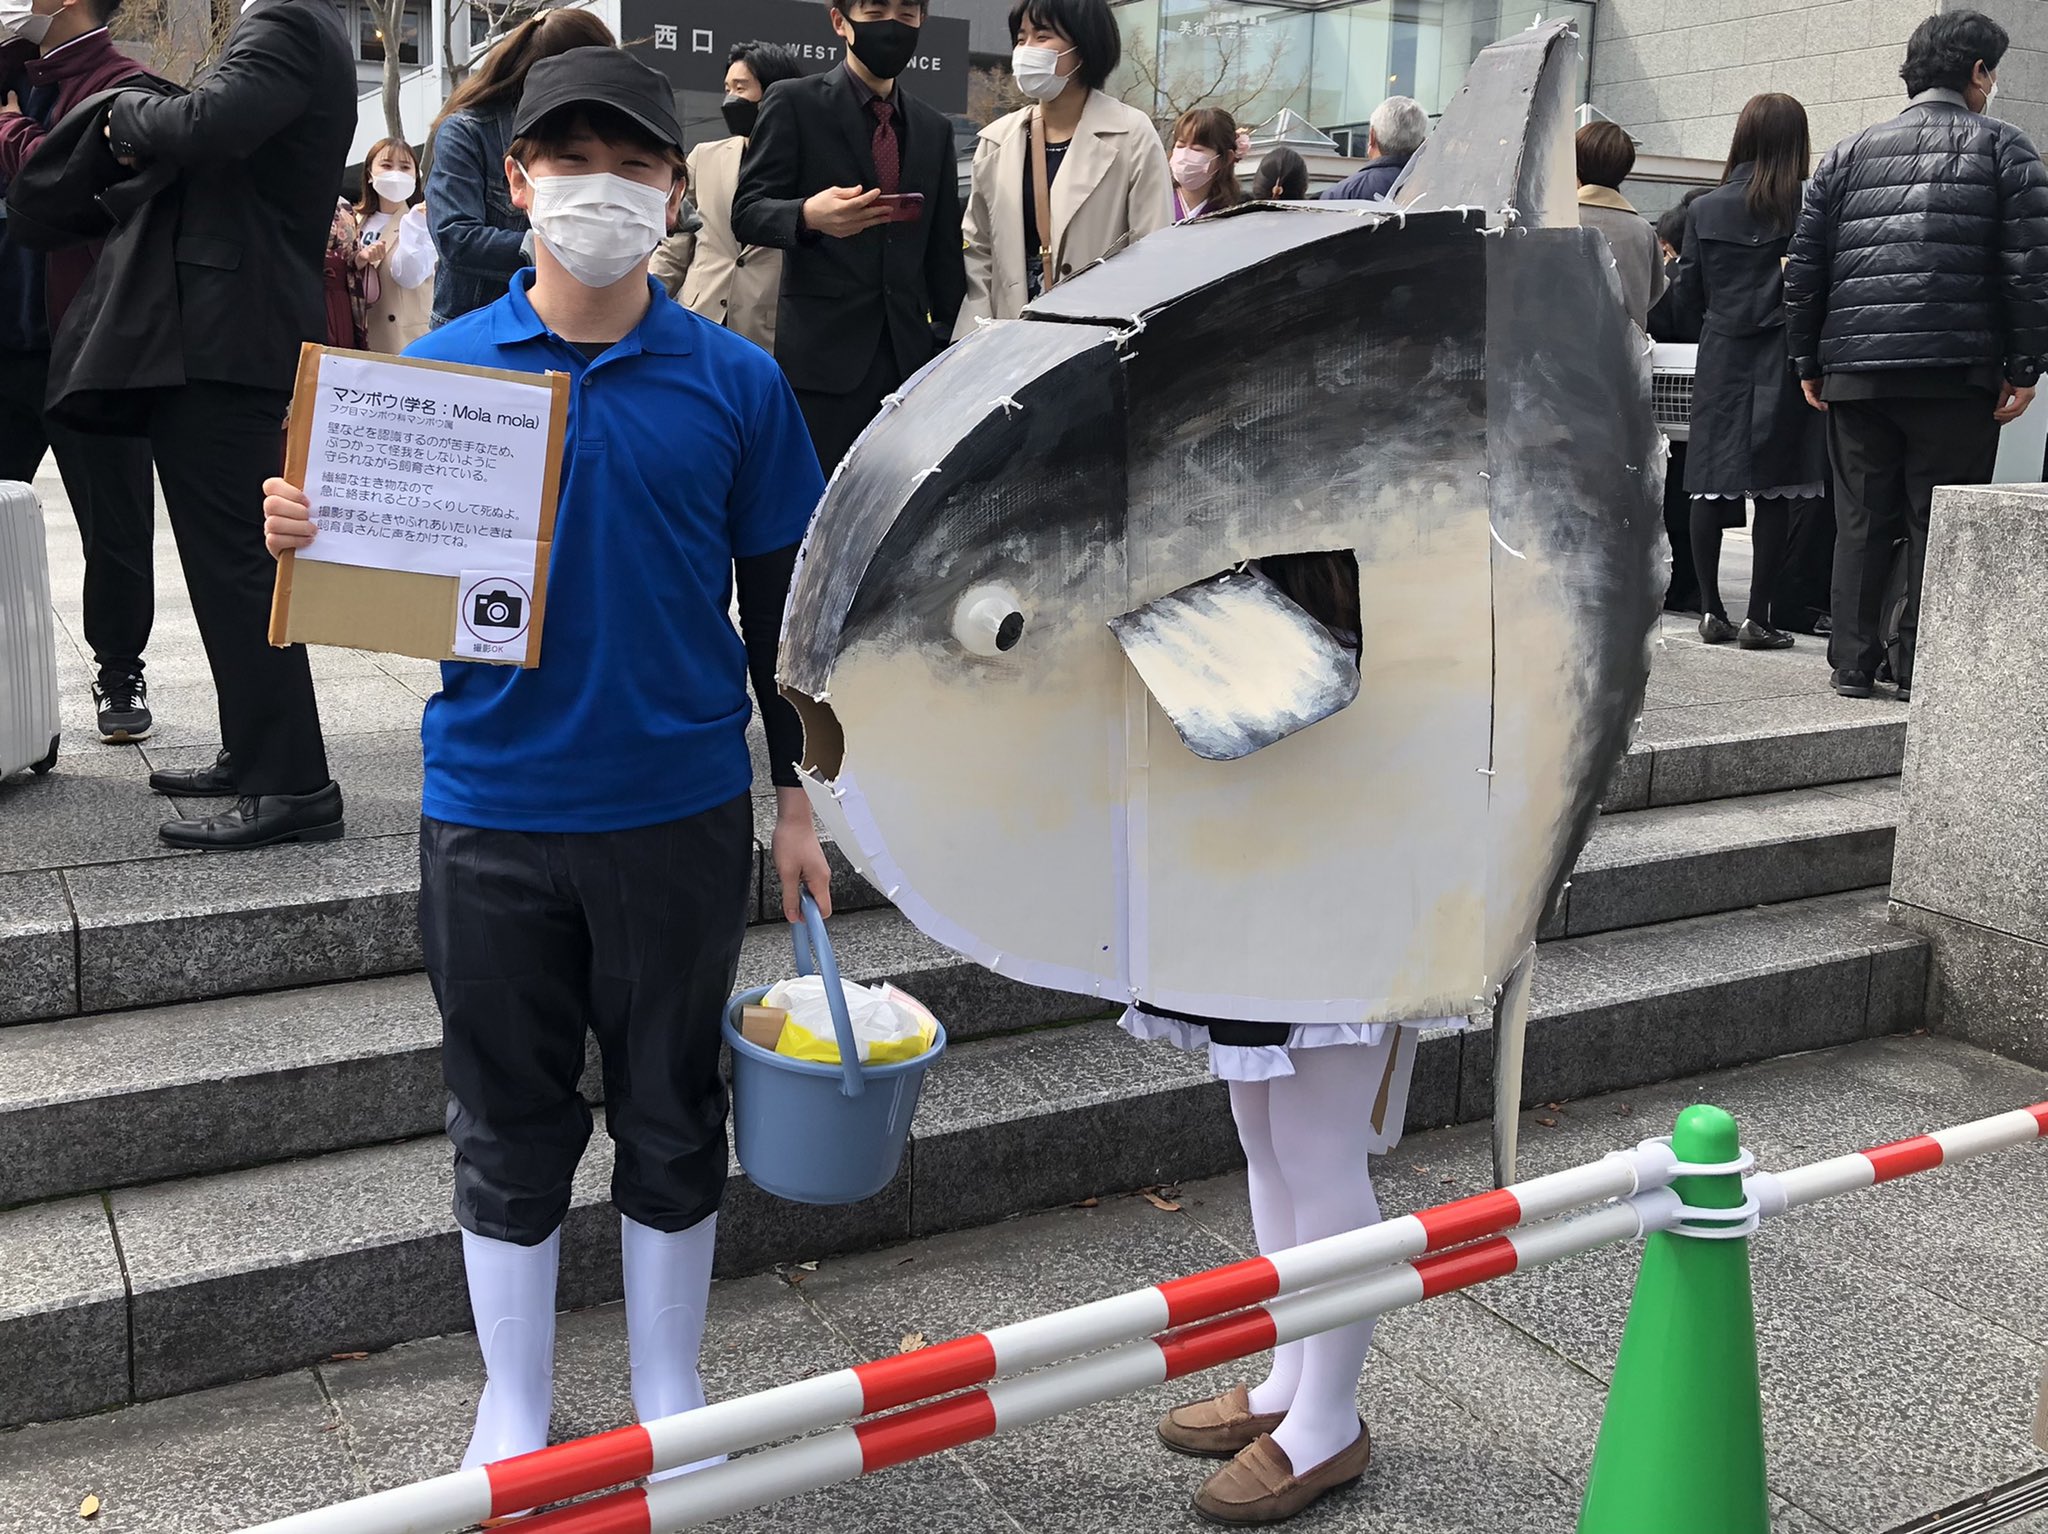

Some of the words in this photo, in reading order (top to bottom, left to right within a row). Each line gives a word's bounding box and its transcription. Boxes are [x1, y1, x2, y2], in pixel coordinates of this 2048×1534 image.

[655, 24, 713, 54] 西口
[787, 42, 838, 61] WEST
[329, 404, 454, 430] フグ目マンボウ科マンボウ属
[497, 414, 540, 430] mola)
[325, 436, 497, 470] ぶつかって怪我をしないように
[327, 421, 515, 459] 壁などを認識するのが苦手なため、
[324, 450, 488, 483] 守られながら飼育されている。
[321, 471, 434, 496] 繊細な生き物なので
[319, 484, 520, 521] 急に絡まれるとびっくりして死ぬよ。
[316, 519, 468, 549] 飼育員さんに声をかけてね。
[318, 506, 513, 540] 撮影するときやふれあいたいときは
[473, 643, 504, 654] 撮影OK
